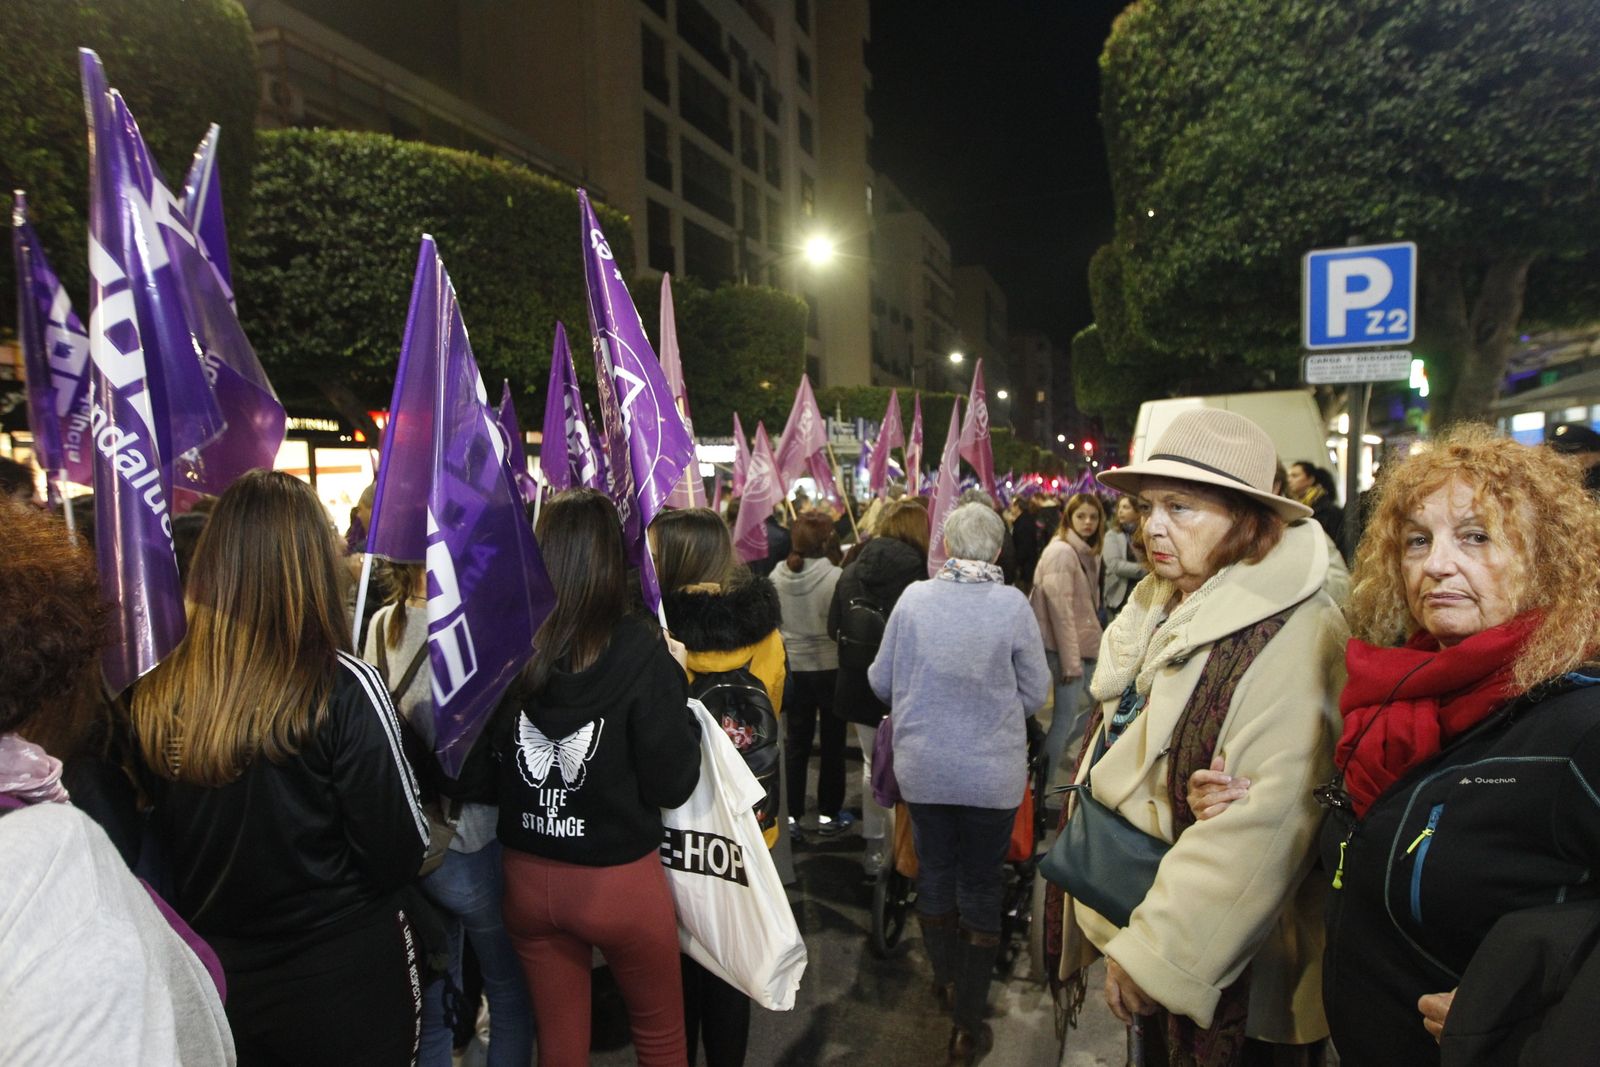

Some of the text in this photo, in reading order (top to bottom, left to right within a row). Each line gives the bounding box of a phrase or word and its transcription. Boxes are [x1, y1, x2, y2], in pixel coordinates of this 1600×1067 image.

[1326, 256, 1394, 338] P
[1365, 308, 1408, 336] Z2
[1474, 776, 1517, 784] Quechua
[539, 788, 567, 806] LIFE
[522, 812, 585, 838] STRANGE
